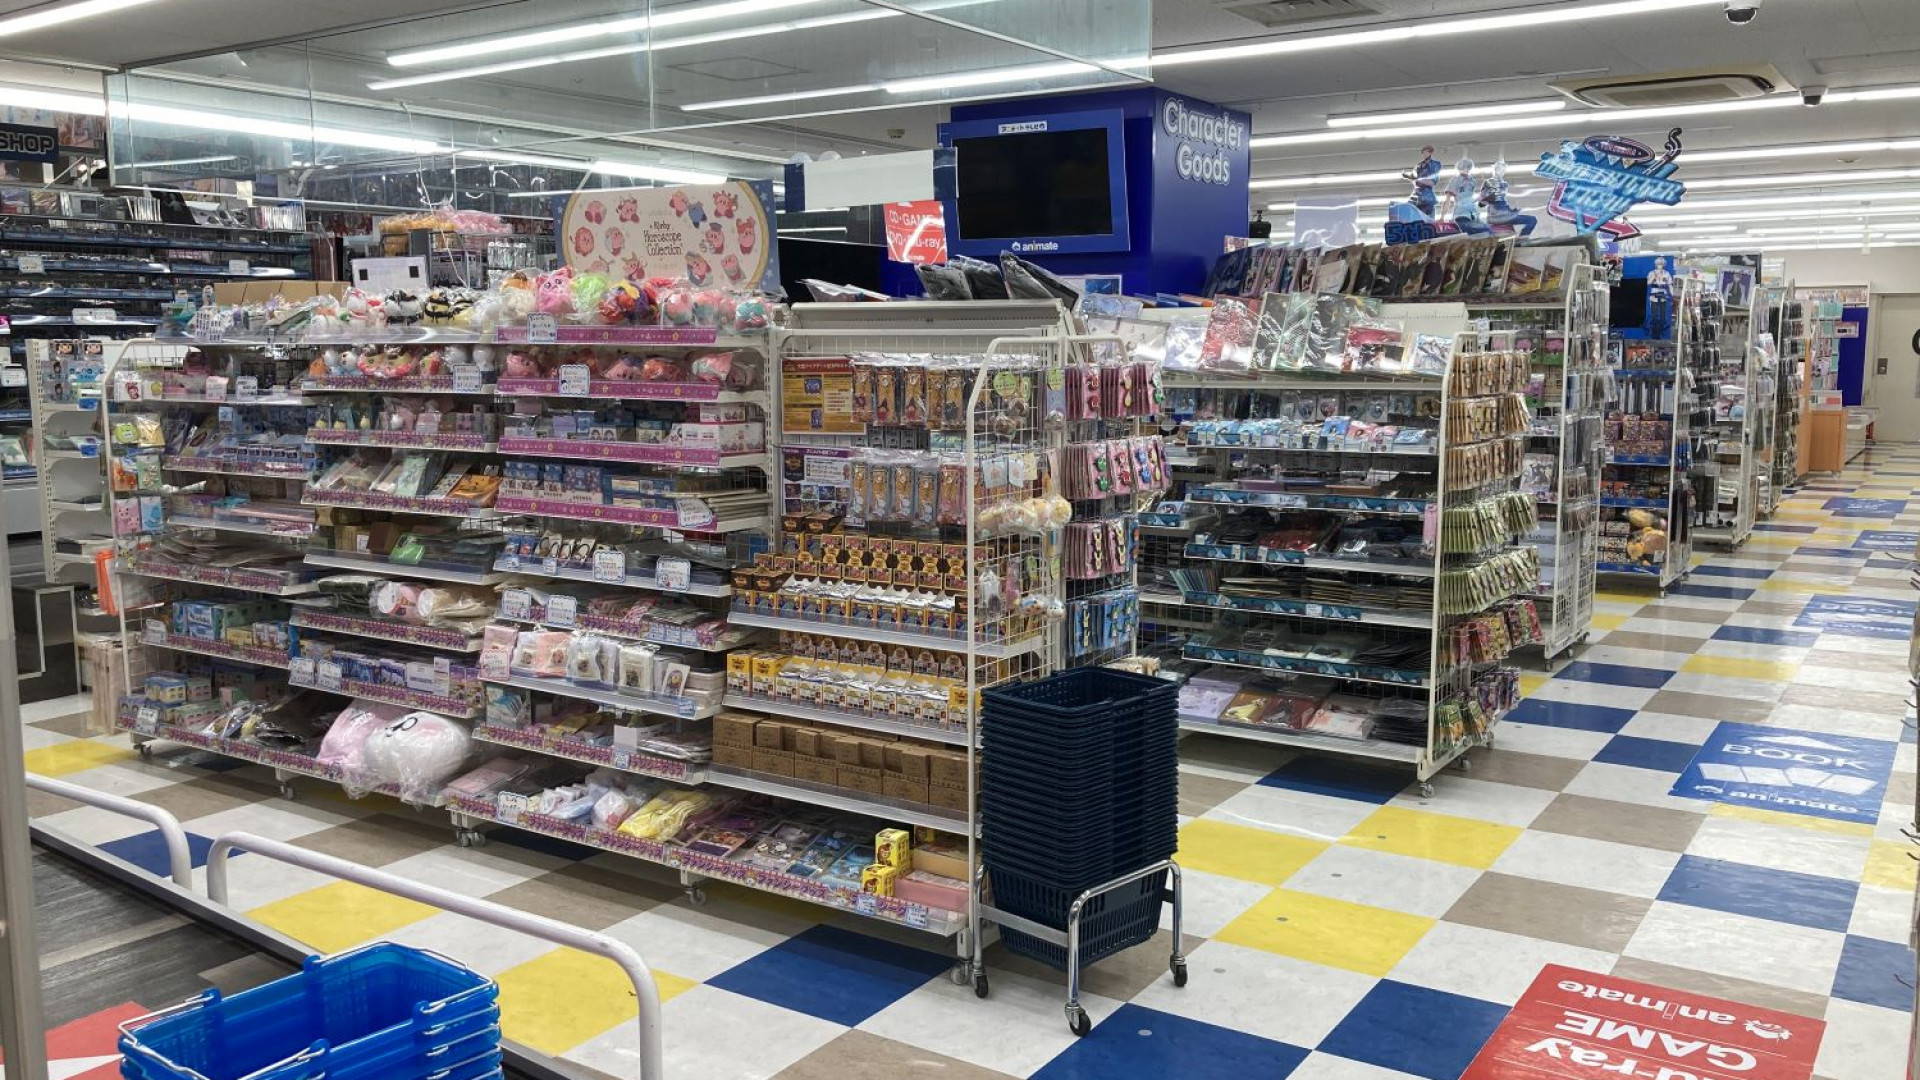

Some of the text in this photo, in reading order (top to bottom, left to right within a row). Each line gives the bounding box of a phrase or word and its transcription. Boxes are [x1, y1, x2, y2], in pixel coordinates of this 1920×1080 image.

[1164, 97, 1244, 150] Character
[0, 131, 54, 155] SHOP
[1176, 140, 1231, 185] Goods
[643, 230, 682, 244] Horoscope
[1022, 240, 1059, 252] animate
[1385, 222, 1436, 244] 5th
[646, 243, 683, 256] Collection
[1721, 742, 1870, 770] BOOK
[1729, 790, 1859, 814] animate
[1557, 980, 1738, 1026] animate
[1555, 1011, 1758, 1072] GAME
[1525, 1036, 1718, 1080] u-ray
